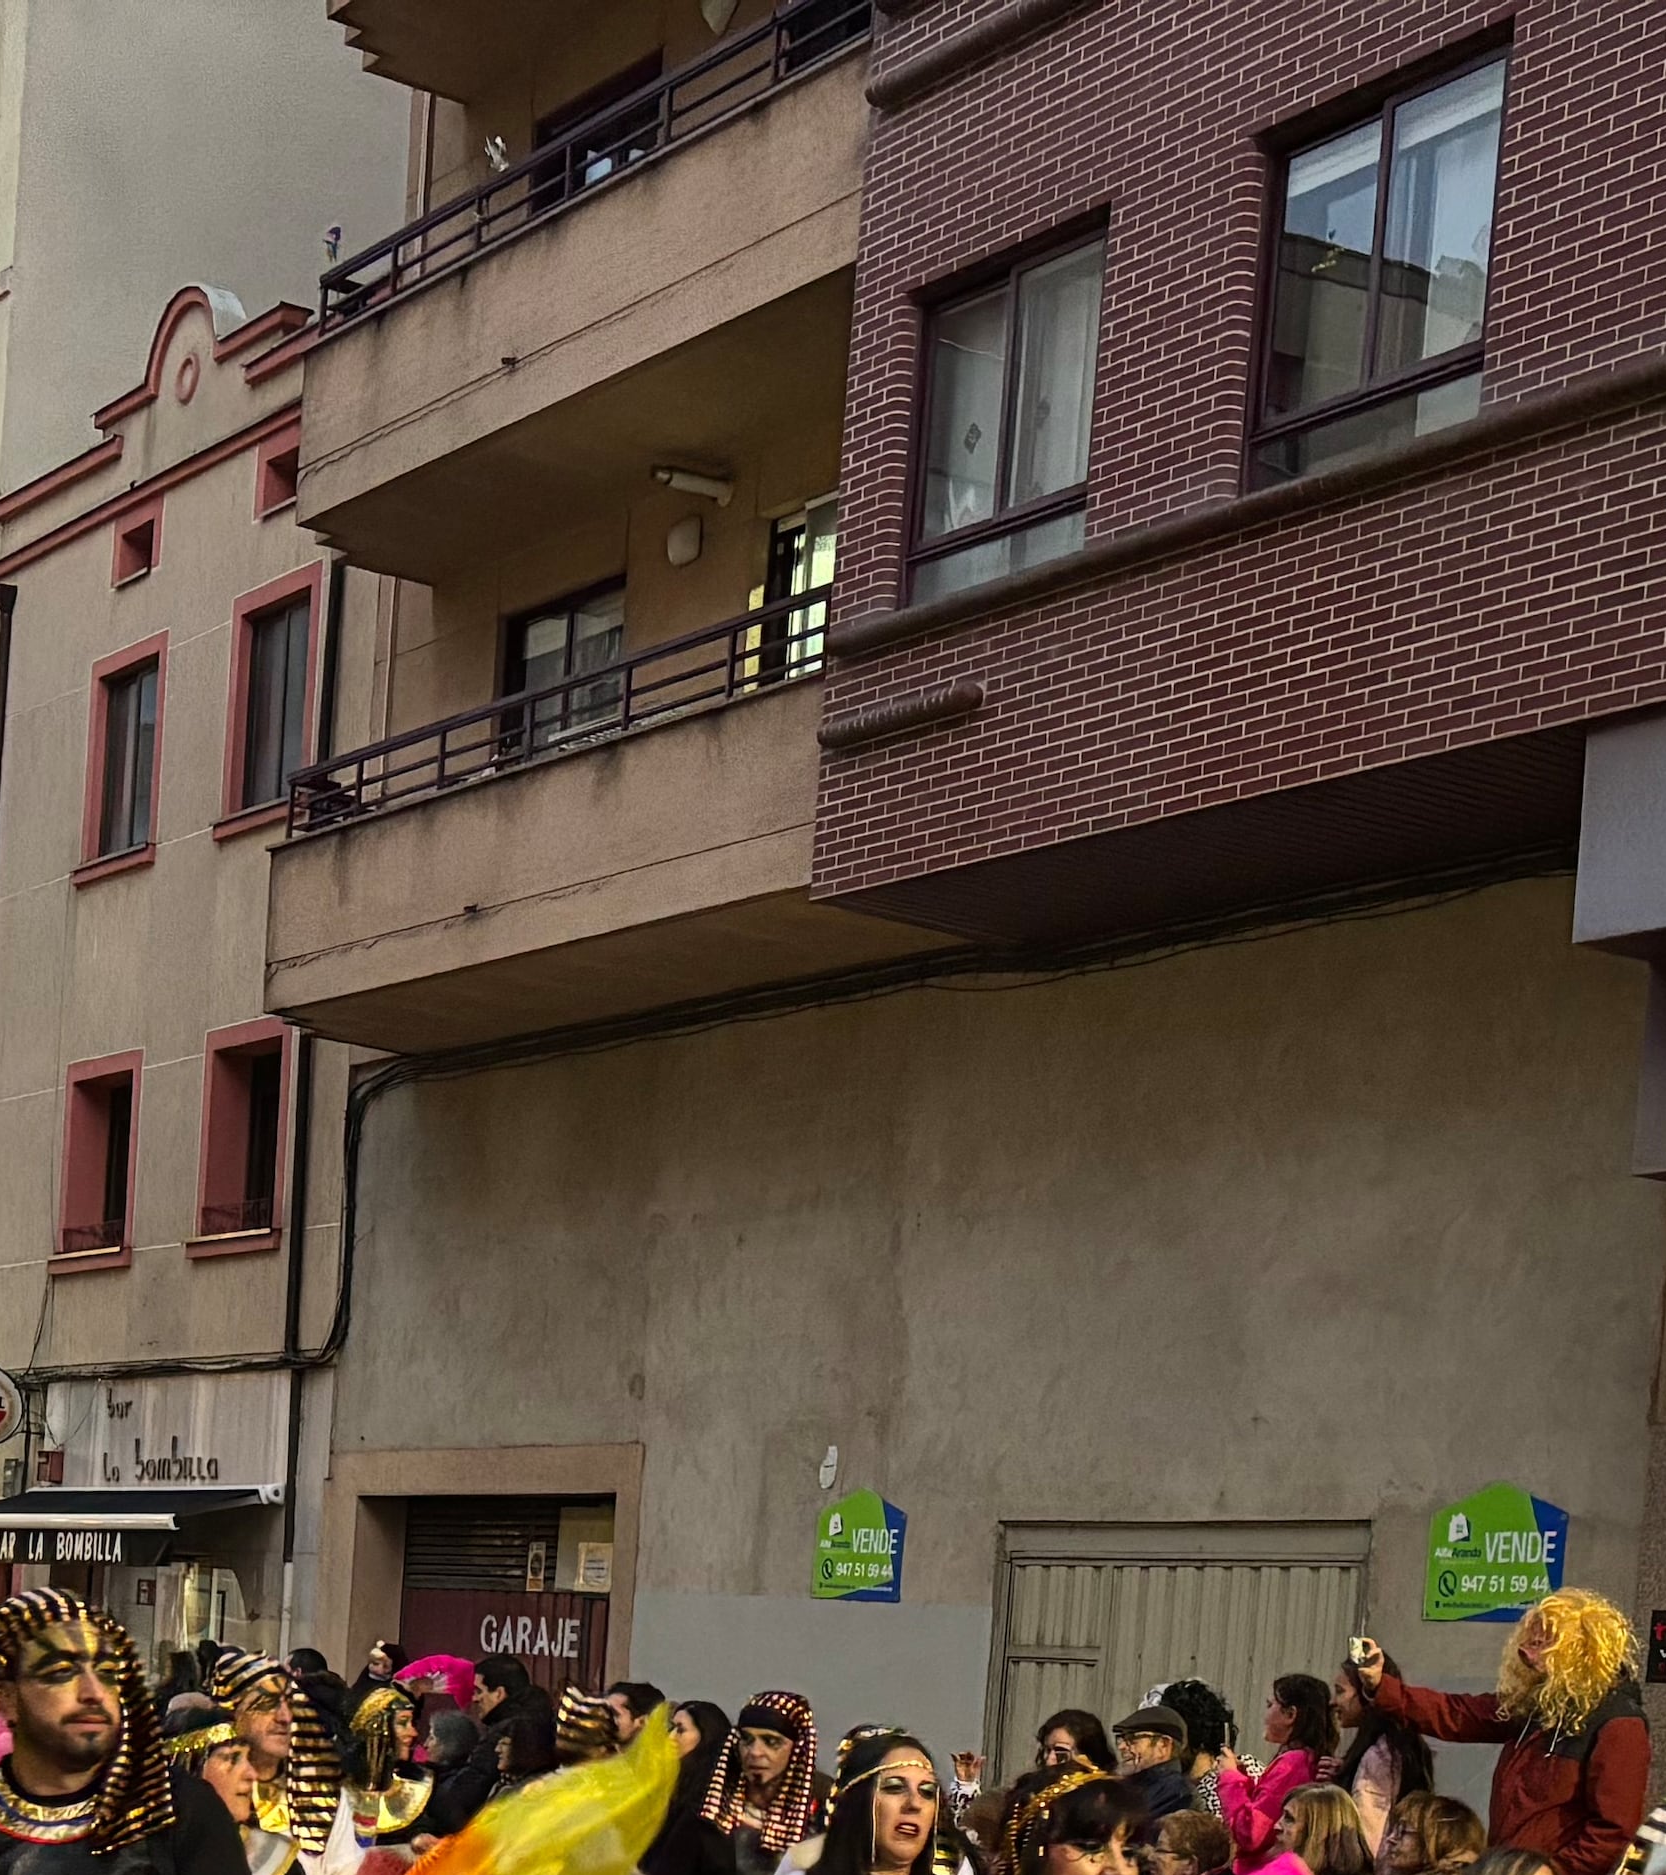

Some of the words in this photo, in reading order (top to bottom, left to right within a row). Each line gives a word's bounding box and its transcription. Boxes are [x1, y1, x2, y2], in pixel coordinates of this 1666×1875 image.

[28, 1532, 43, 1561] LA
[56, 1532, 121, 1563] BOMBILLA
[853, 1528, 899, 1555] VENDE
[1485, 1531, 1558, 1563] VENDE
[836, 1562, 852, 1577] 947
[854, 1562, 865, 1577] 51
[1461, 1575, 1486, 1592] 947
[1489, 1575, 1505, 1592] 51
[1510, 1575, 1527, 1593] 59
[1531, 1576, 1549, 1593] 44
[480, 1614, 580, 1658] GARAJE
